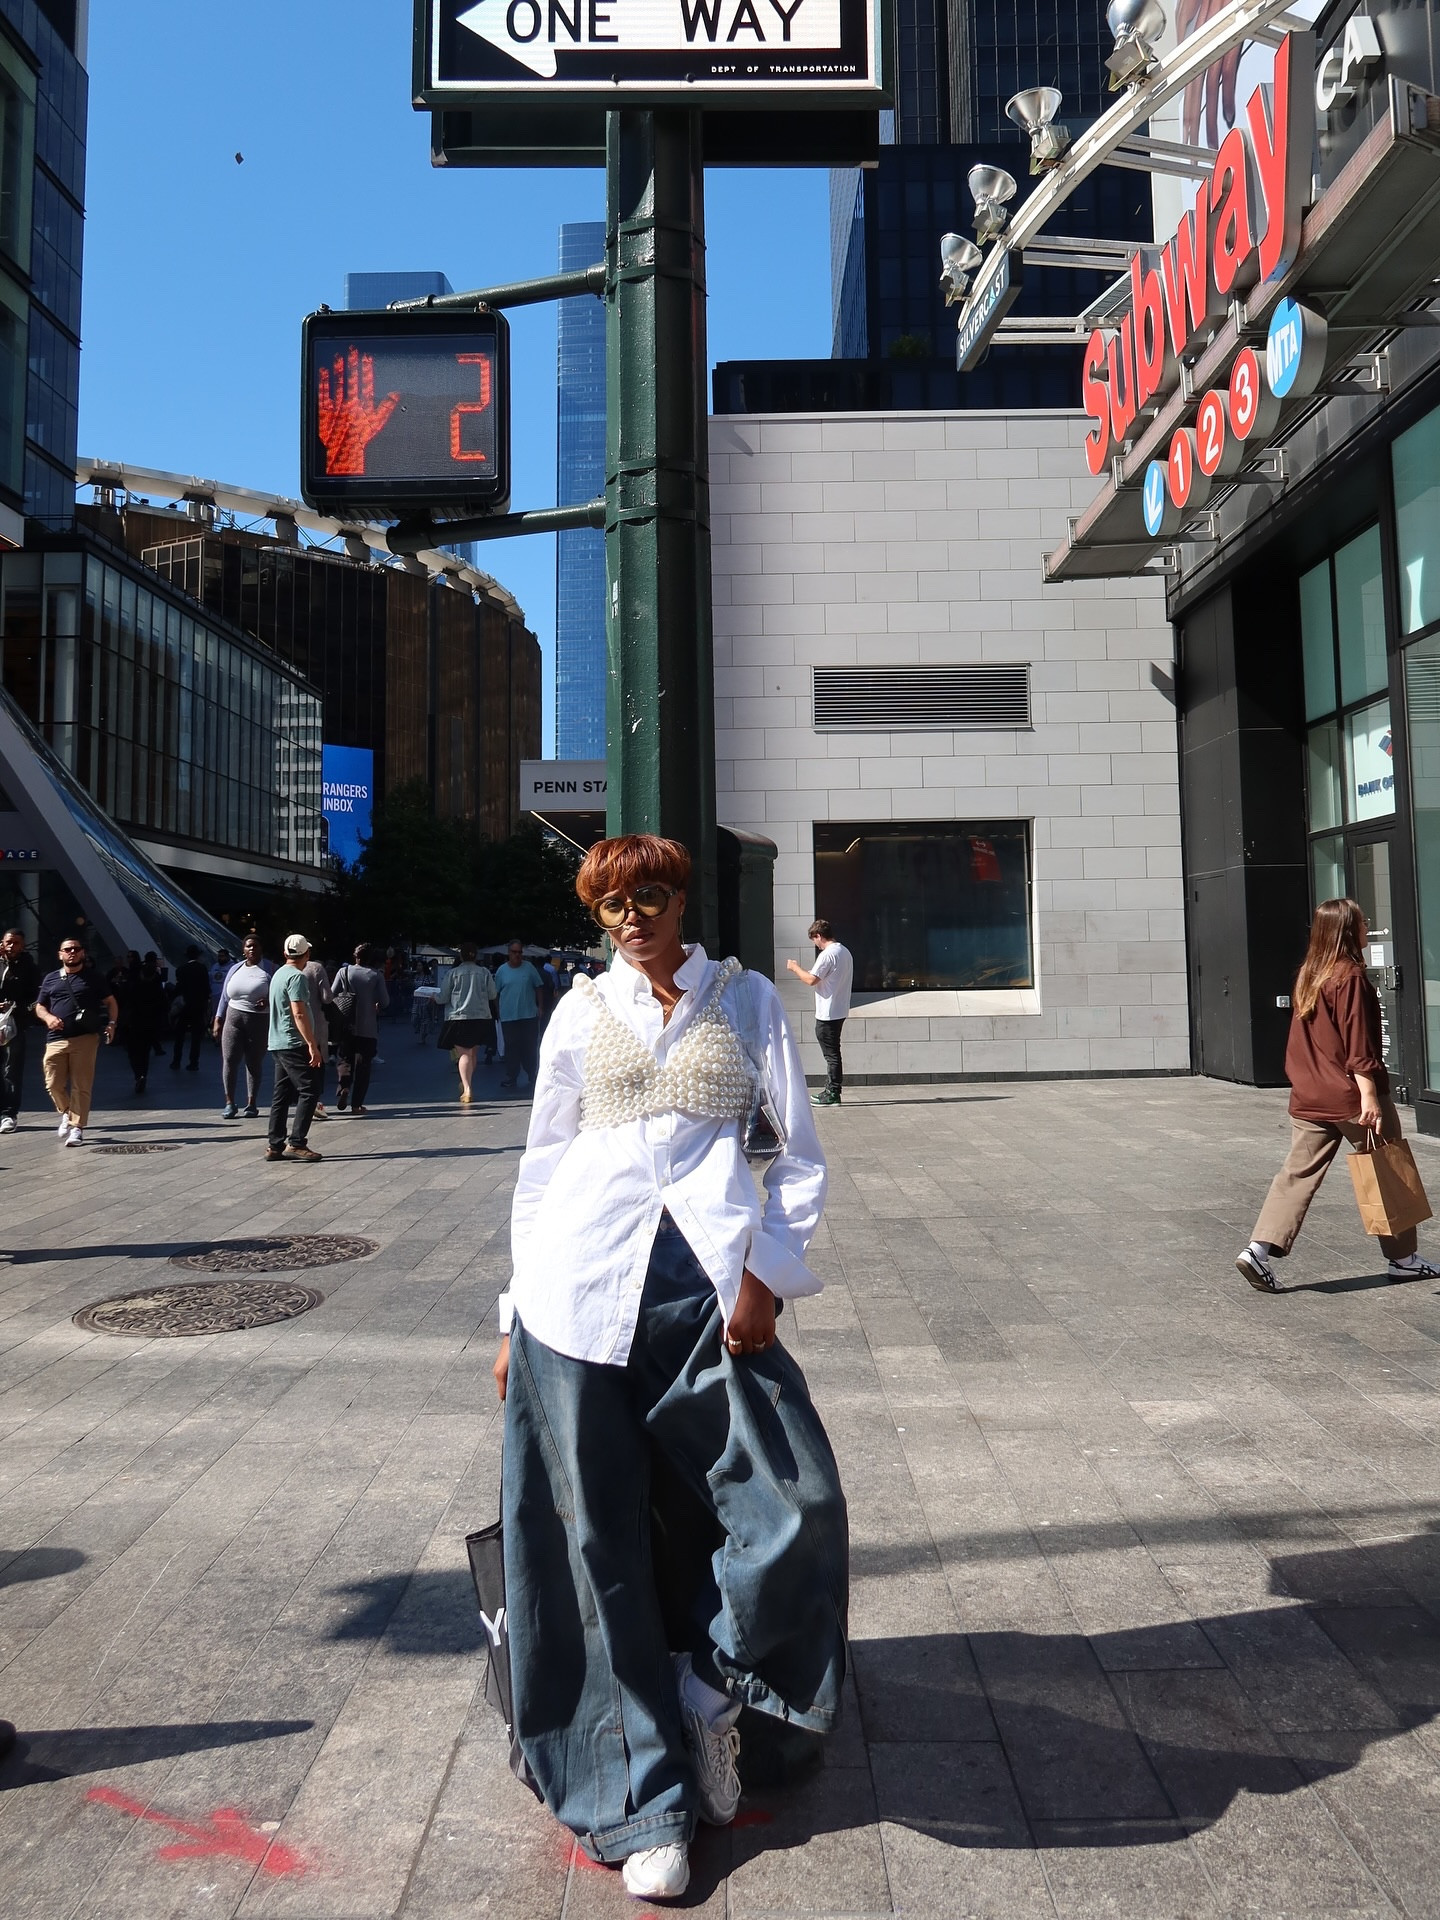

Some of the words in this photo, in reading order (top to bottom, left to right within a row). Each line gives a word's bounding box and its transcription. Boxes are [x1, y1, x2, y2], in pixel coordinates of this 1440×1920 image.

[506, 0, 619, 43] ONE
[680, 0, 803, 42] WAY
[769, 65, 856, 73] TRANSPORTATION
[1082, 30, 1292, 476] Subway
[450, 353, 491, 462] 2
[1173, 442, 1185, 493] 1
[1202, 405, 1219, 465] 2
[1235, 362, 1253, 425] 3
[1266, 319, 1299, 391] MTA
[322, 782, 368, 799] RANGERS
[533, 781, 577, 793] PENN
[323, 797, 353, 813] INBOX
